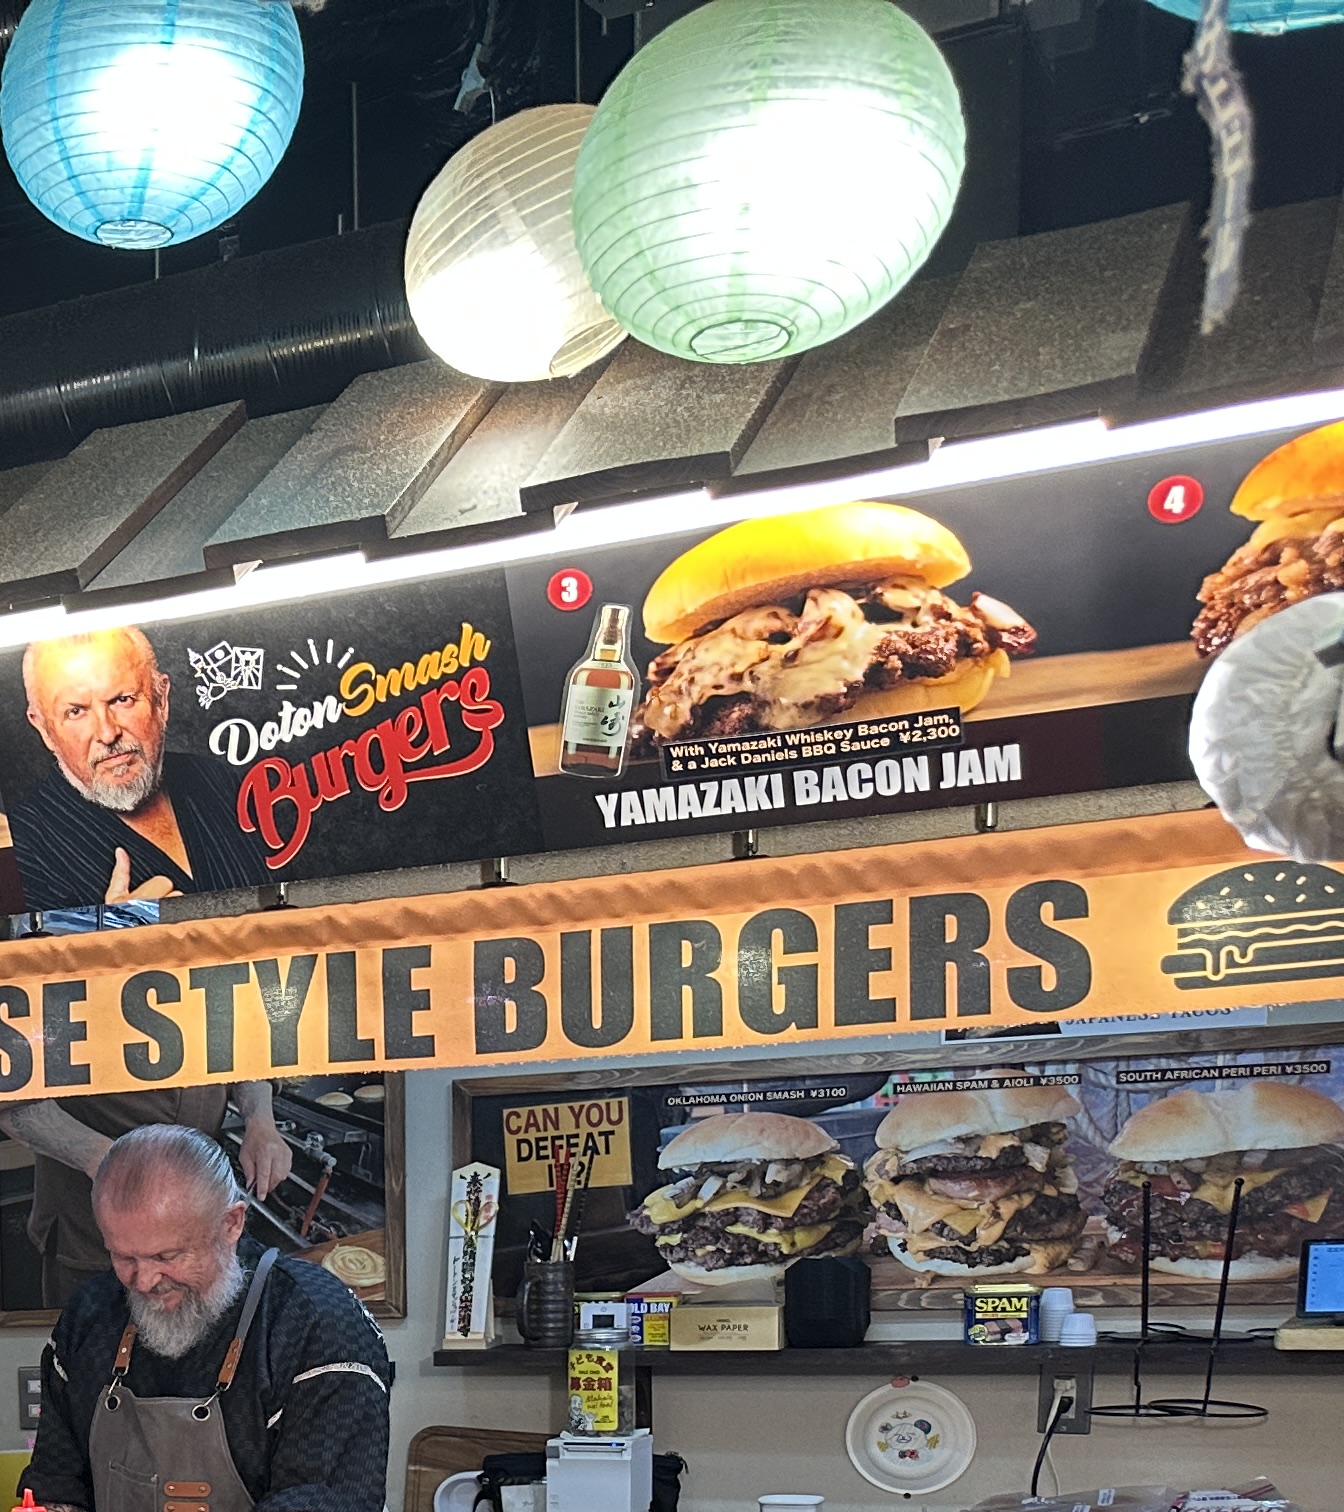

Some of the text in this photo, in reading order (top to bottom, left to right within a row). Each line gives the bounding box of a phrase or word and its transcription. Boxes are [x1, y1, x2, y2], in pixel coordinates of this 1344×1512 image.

[1164, 484, 1185, 514] 4
[561, 577, 578, 602] 3
[209, 622, 492, 767] Doton Smash
[670, 712, 954, 759] With Yamazaki Whiskey Bacon Jam,
[700, 724, 961, 768] Jack Daniels BBQ Sauce ¥2,300
[237, 666, 506, 870] Burgers
[596, 744, 1021, 828] YAMAZAKI BACON JAM
[120, 944, 433, 1084] STYLE
[474, 879, 1091, 1055] BURGERS
[896, 1073, 1079, 1094] HAWAIIAN SPAM AIOLI ¥3500
[1118, 1062, 1328, 1082] SOUTH AFRICAN PERI PERI ¥3500
[667, 1086, 846, 1106] OKLAHOMA ONION SMASH ¥3100
[505, 1101, 624, 1135] CAN YOU
[516, 1131, 616, 1163] DEFEAT
[650, 1301, 672, 1314] BAY
[974, 1296, 1029, 1312] SPAM
[720, 1322, 750, 1333] PAPER
